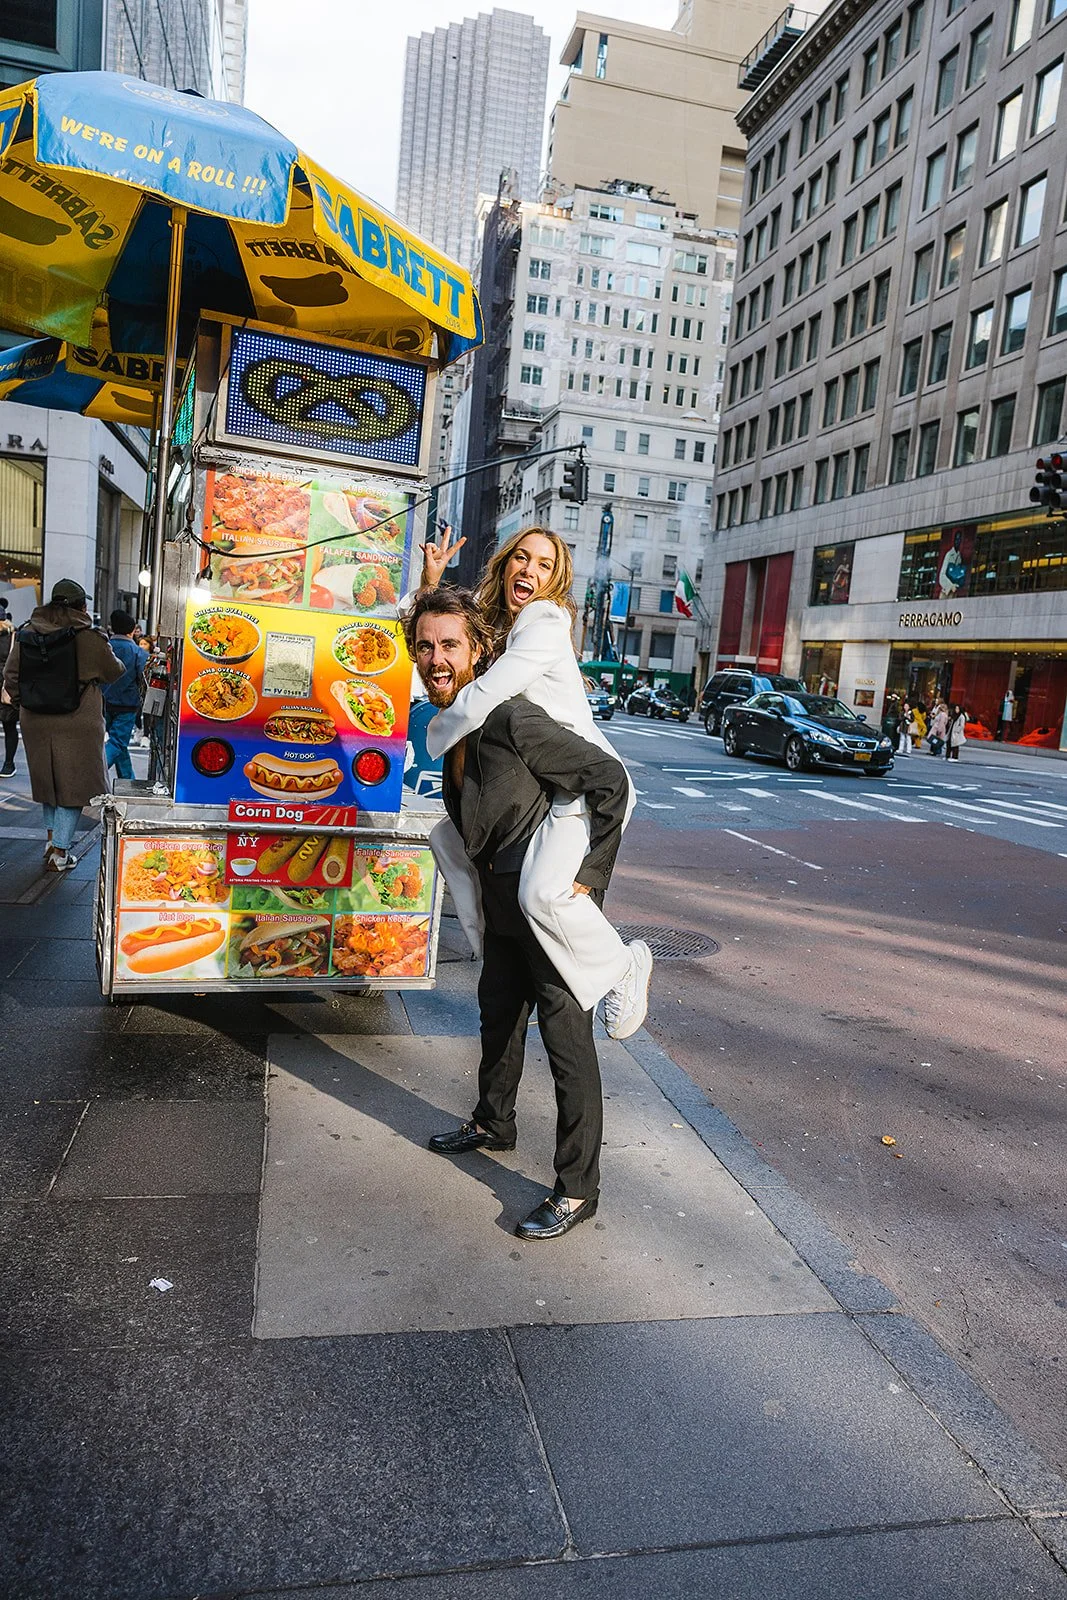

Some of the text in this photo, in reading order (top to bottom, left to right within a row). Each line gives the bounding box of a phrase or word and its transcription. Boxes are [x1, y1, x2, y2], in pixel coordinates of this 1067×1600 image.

[60, 116, 267, 196] WE'RE ON A ROLL !!!
[314, 182, 466, 319] SABRETT
[0, 434, 48, 451] RA
[228, 466, 300, 483] CHICKEN KEBAB
[221, 532, 297, 549] ITALIAN SAUSAGE
[319, 546, 398, 564] FALAFEL SANDWICH
[898, 611, 963, 627] FERRAGAMO
[198, 668, 216, 677] LAMB
[236, 670, 251, 680] RICE
[284, 750, 316, 760] HOT DOG
[235, 804, 304, 822] Corn Dog
[144, 841, 223, 852] Chicken over Rice
[237, 836, 260, 848] NY
[355, 848, 421, 858] Falafel Sandwich
[159, 912, 196, 923] Hot Dog
[255, 913, 317, 924] Italian Sausage
[354, 914, 412, 923] Chicken Kebab
